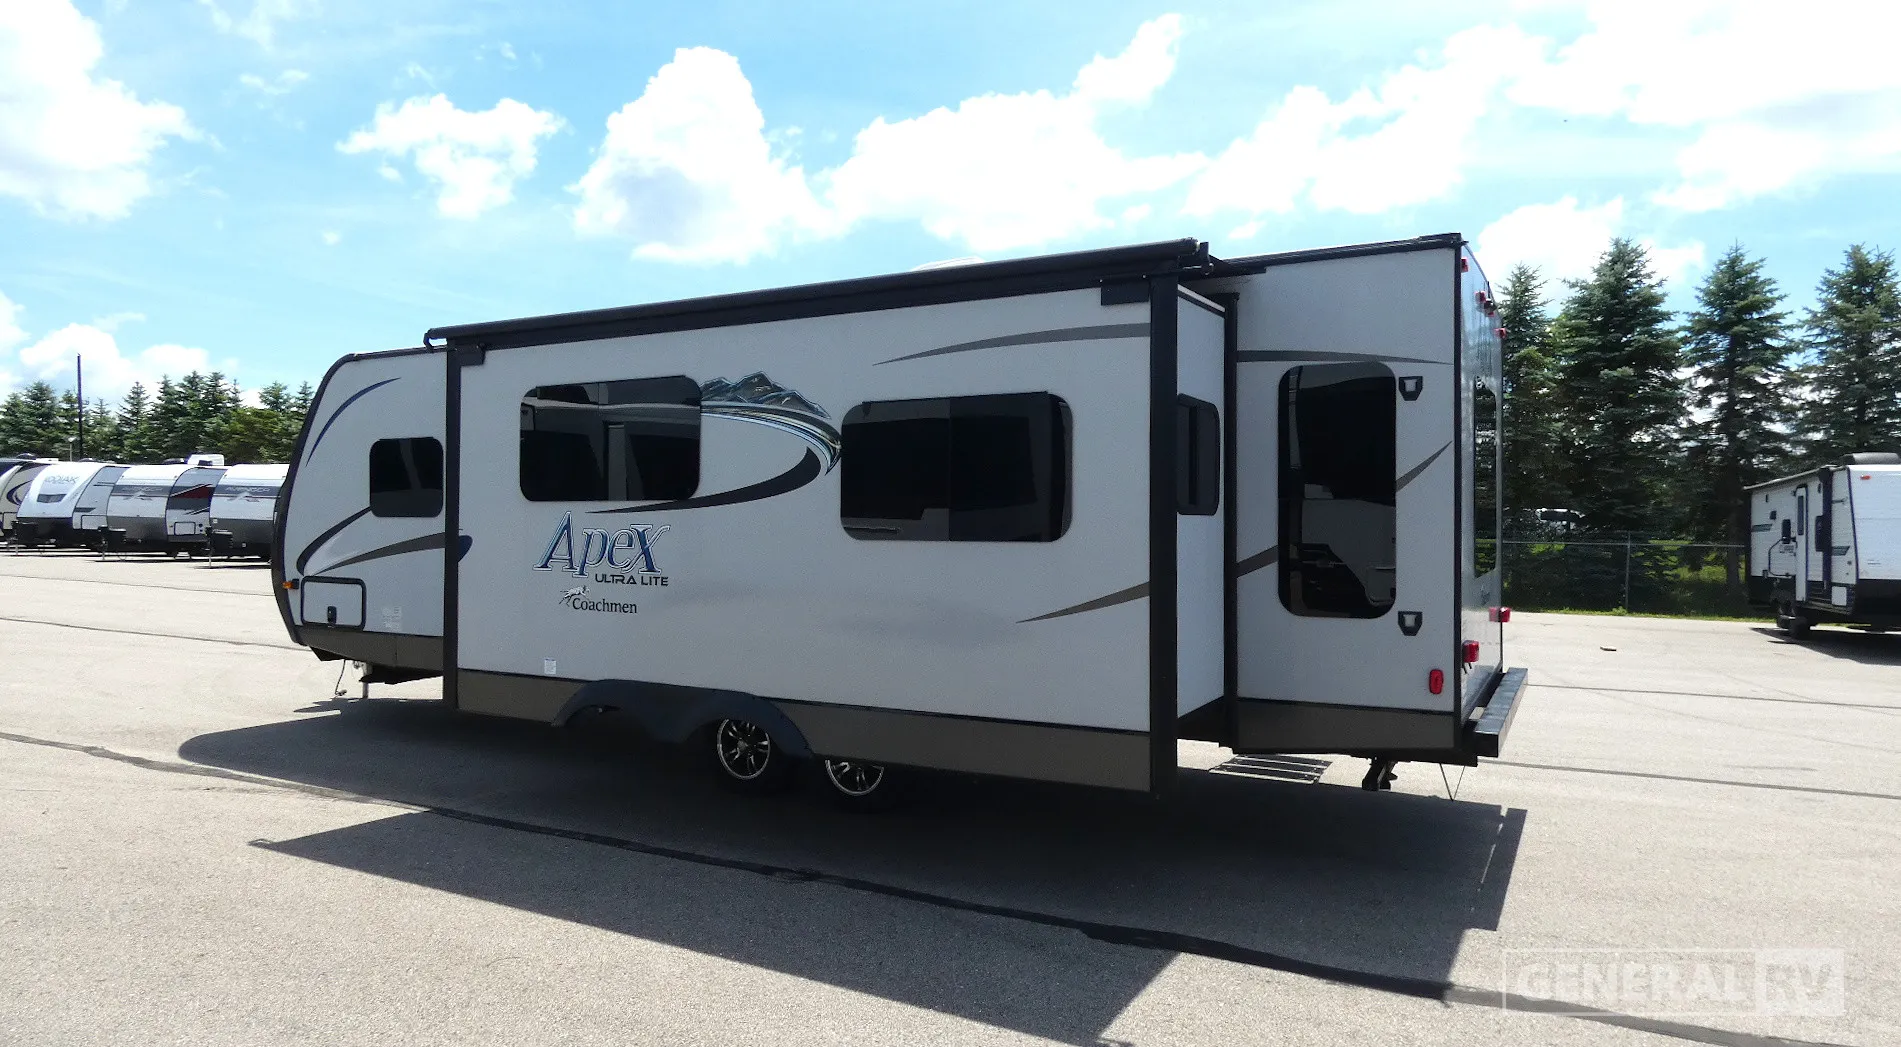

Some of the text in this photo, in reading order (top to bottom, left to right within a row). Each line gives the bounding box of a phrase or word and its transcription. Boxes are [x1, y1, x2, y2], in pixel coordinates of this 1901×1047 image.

[595, 574, 669, 586] ULTRA LITE
[572, 598, 638, 614] Coachmen
